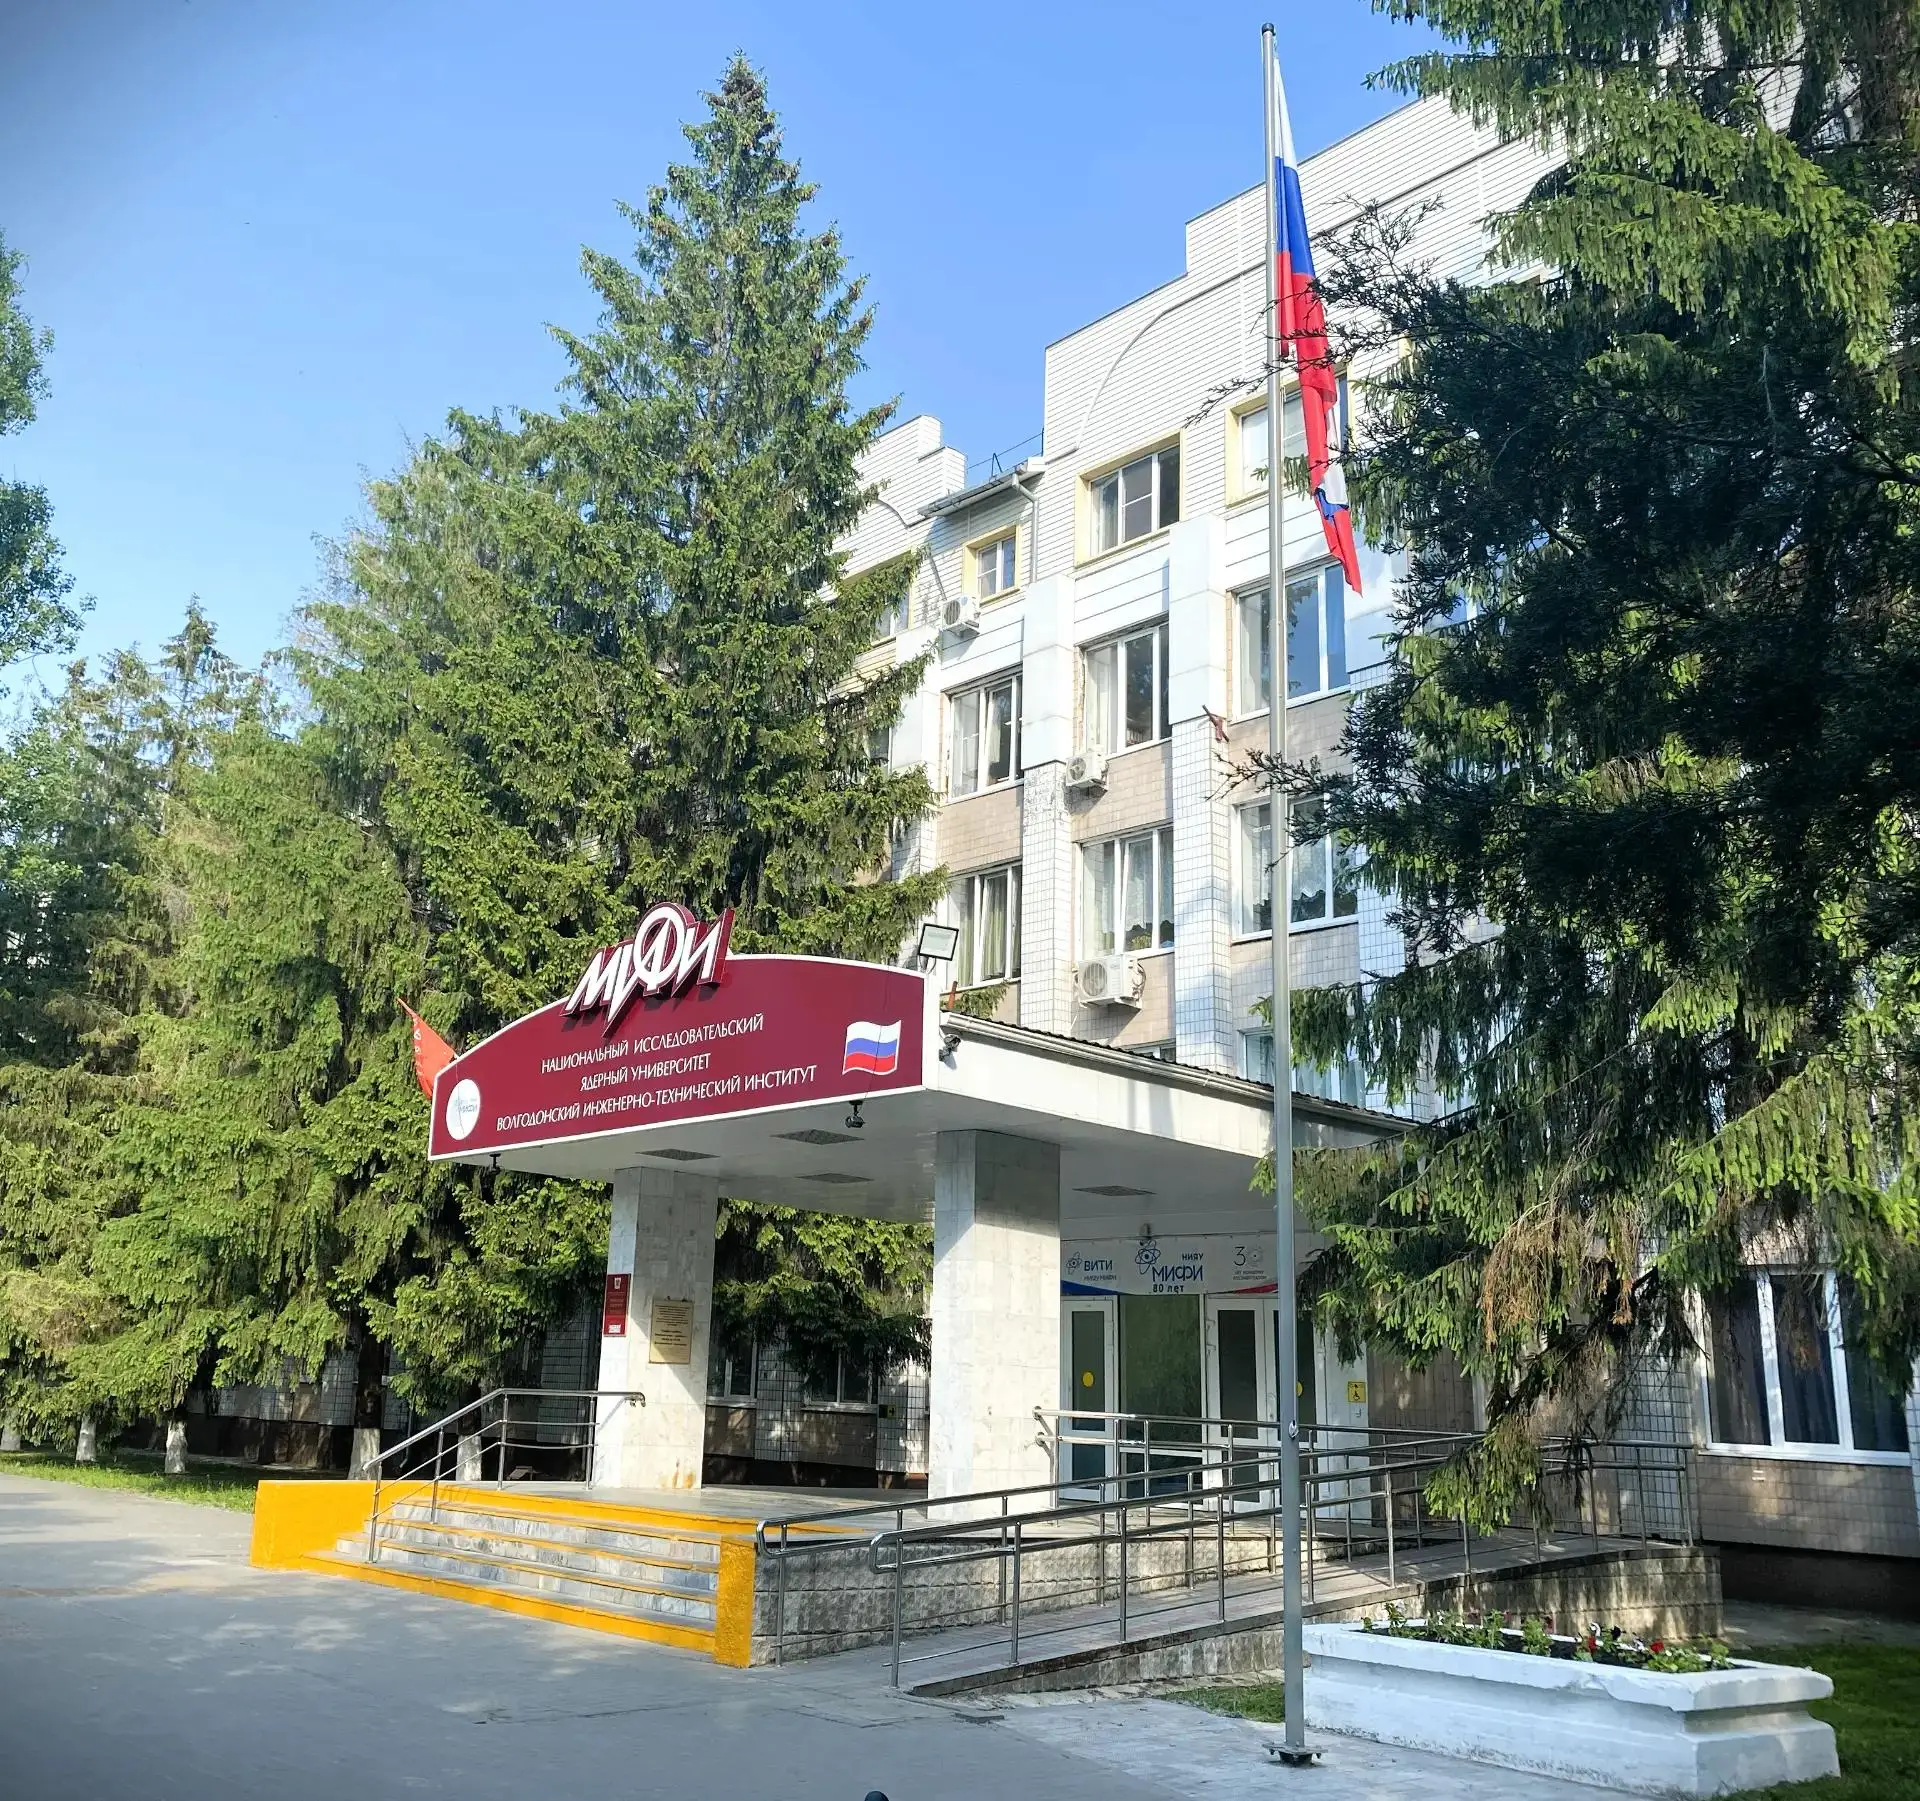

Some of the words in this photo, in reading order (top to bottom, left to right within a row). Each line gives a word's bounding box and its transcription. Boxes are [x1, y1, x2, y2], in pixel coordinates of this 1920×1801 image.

[563, 904, 728, 1030] МИФИ
[542, 1040, 629, 1074] НАЦИОНАЛЬНЫЙ
[633, 1013, 764, 1054] ИССЛЕДОВАТЕЛЬСКИЙ
[580, 1066, 628, 1092] ЯДЕРНЫЙ
[631, 1053, 711, 1081] УНИВЕРСИТЕТ
[496, 1102, 580, 1131] ВОЛГОДОНСКИЙ
[583, 1075, 740, 1117] ИНЖЕНЕРНО-ТЕХНИЧЕСКИЙ
[745, 1065, 817, 1091] ИНСТИТУТ
[1083, 1259, 1113, 1272] ВИТИ
[1181, 1252, 1204, 1261] НИЯУ
[1152, 1264, 1204, 1282] МИФИ
[1152, 1283, 1164, 1293] 80
[1167, 1284, 1185, 1293] лет
